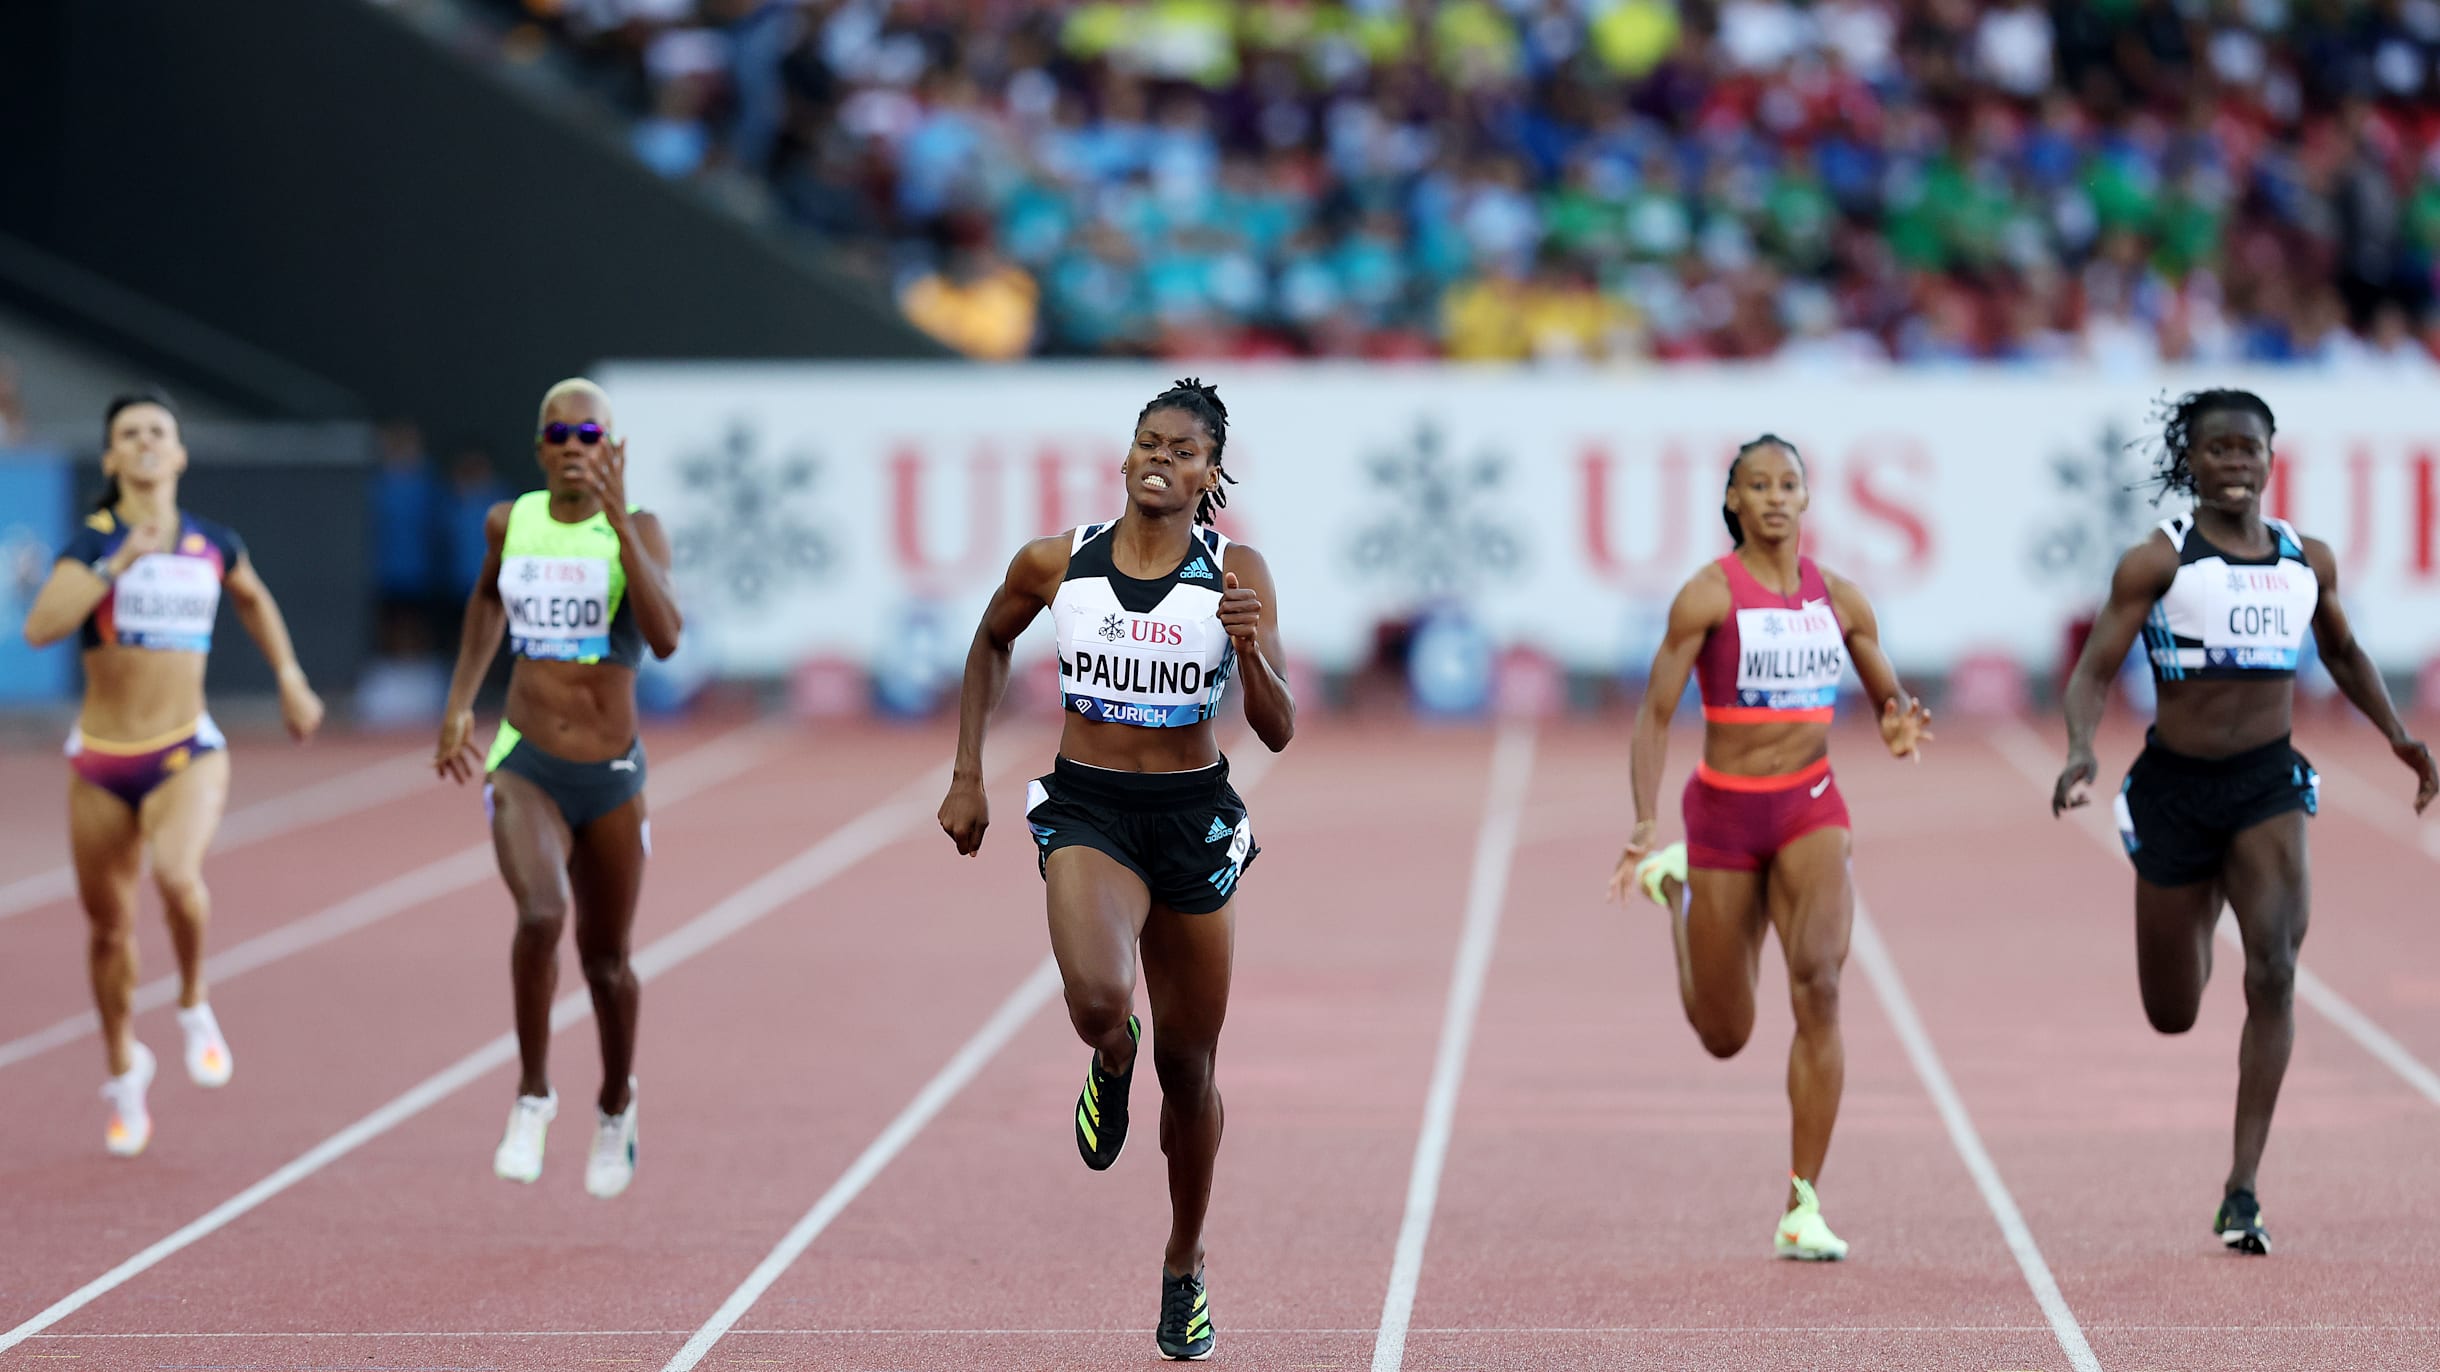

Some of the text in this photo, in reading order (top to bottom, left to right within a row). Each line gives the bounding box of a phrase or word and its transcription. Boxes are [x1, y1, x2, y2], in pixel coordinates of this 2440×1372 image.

[1179, 569, 1214, 580] adidas
[1131, 618, 1183, 646] UBS
[2229, 605, 2289, 636] COFIL
[1075, 651, 1201, 695] PAULINO
[1746, 647, 1841, 679] WILLIAMS
[1102, 703, 1168, 724] ZURICH
[1204, 827, 1234, 844] adidas
[1233, 827, 1246, 855] 6
